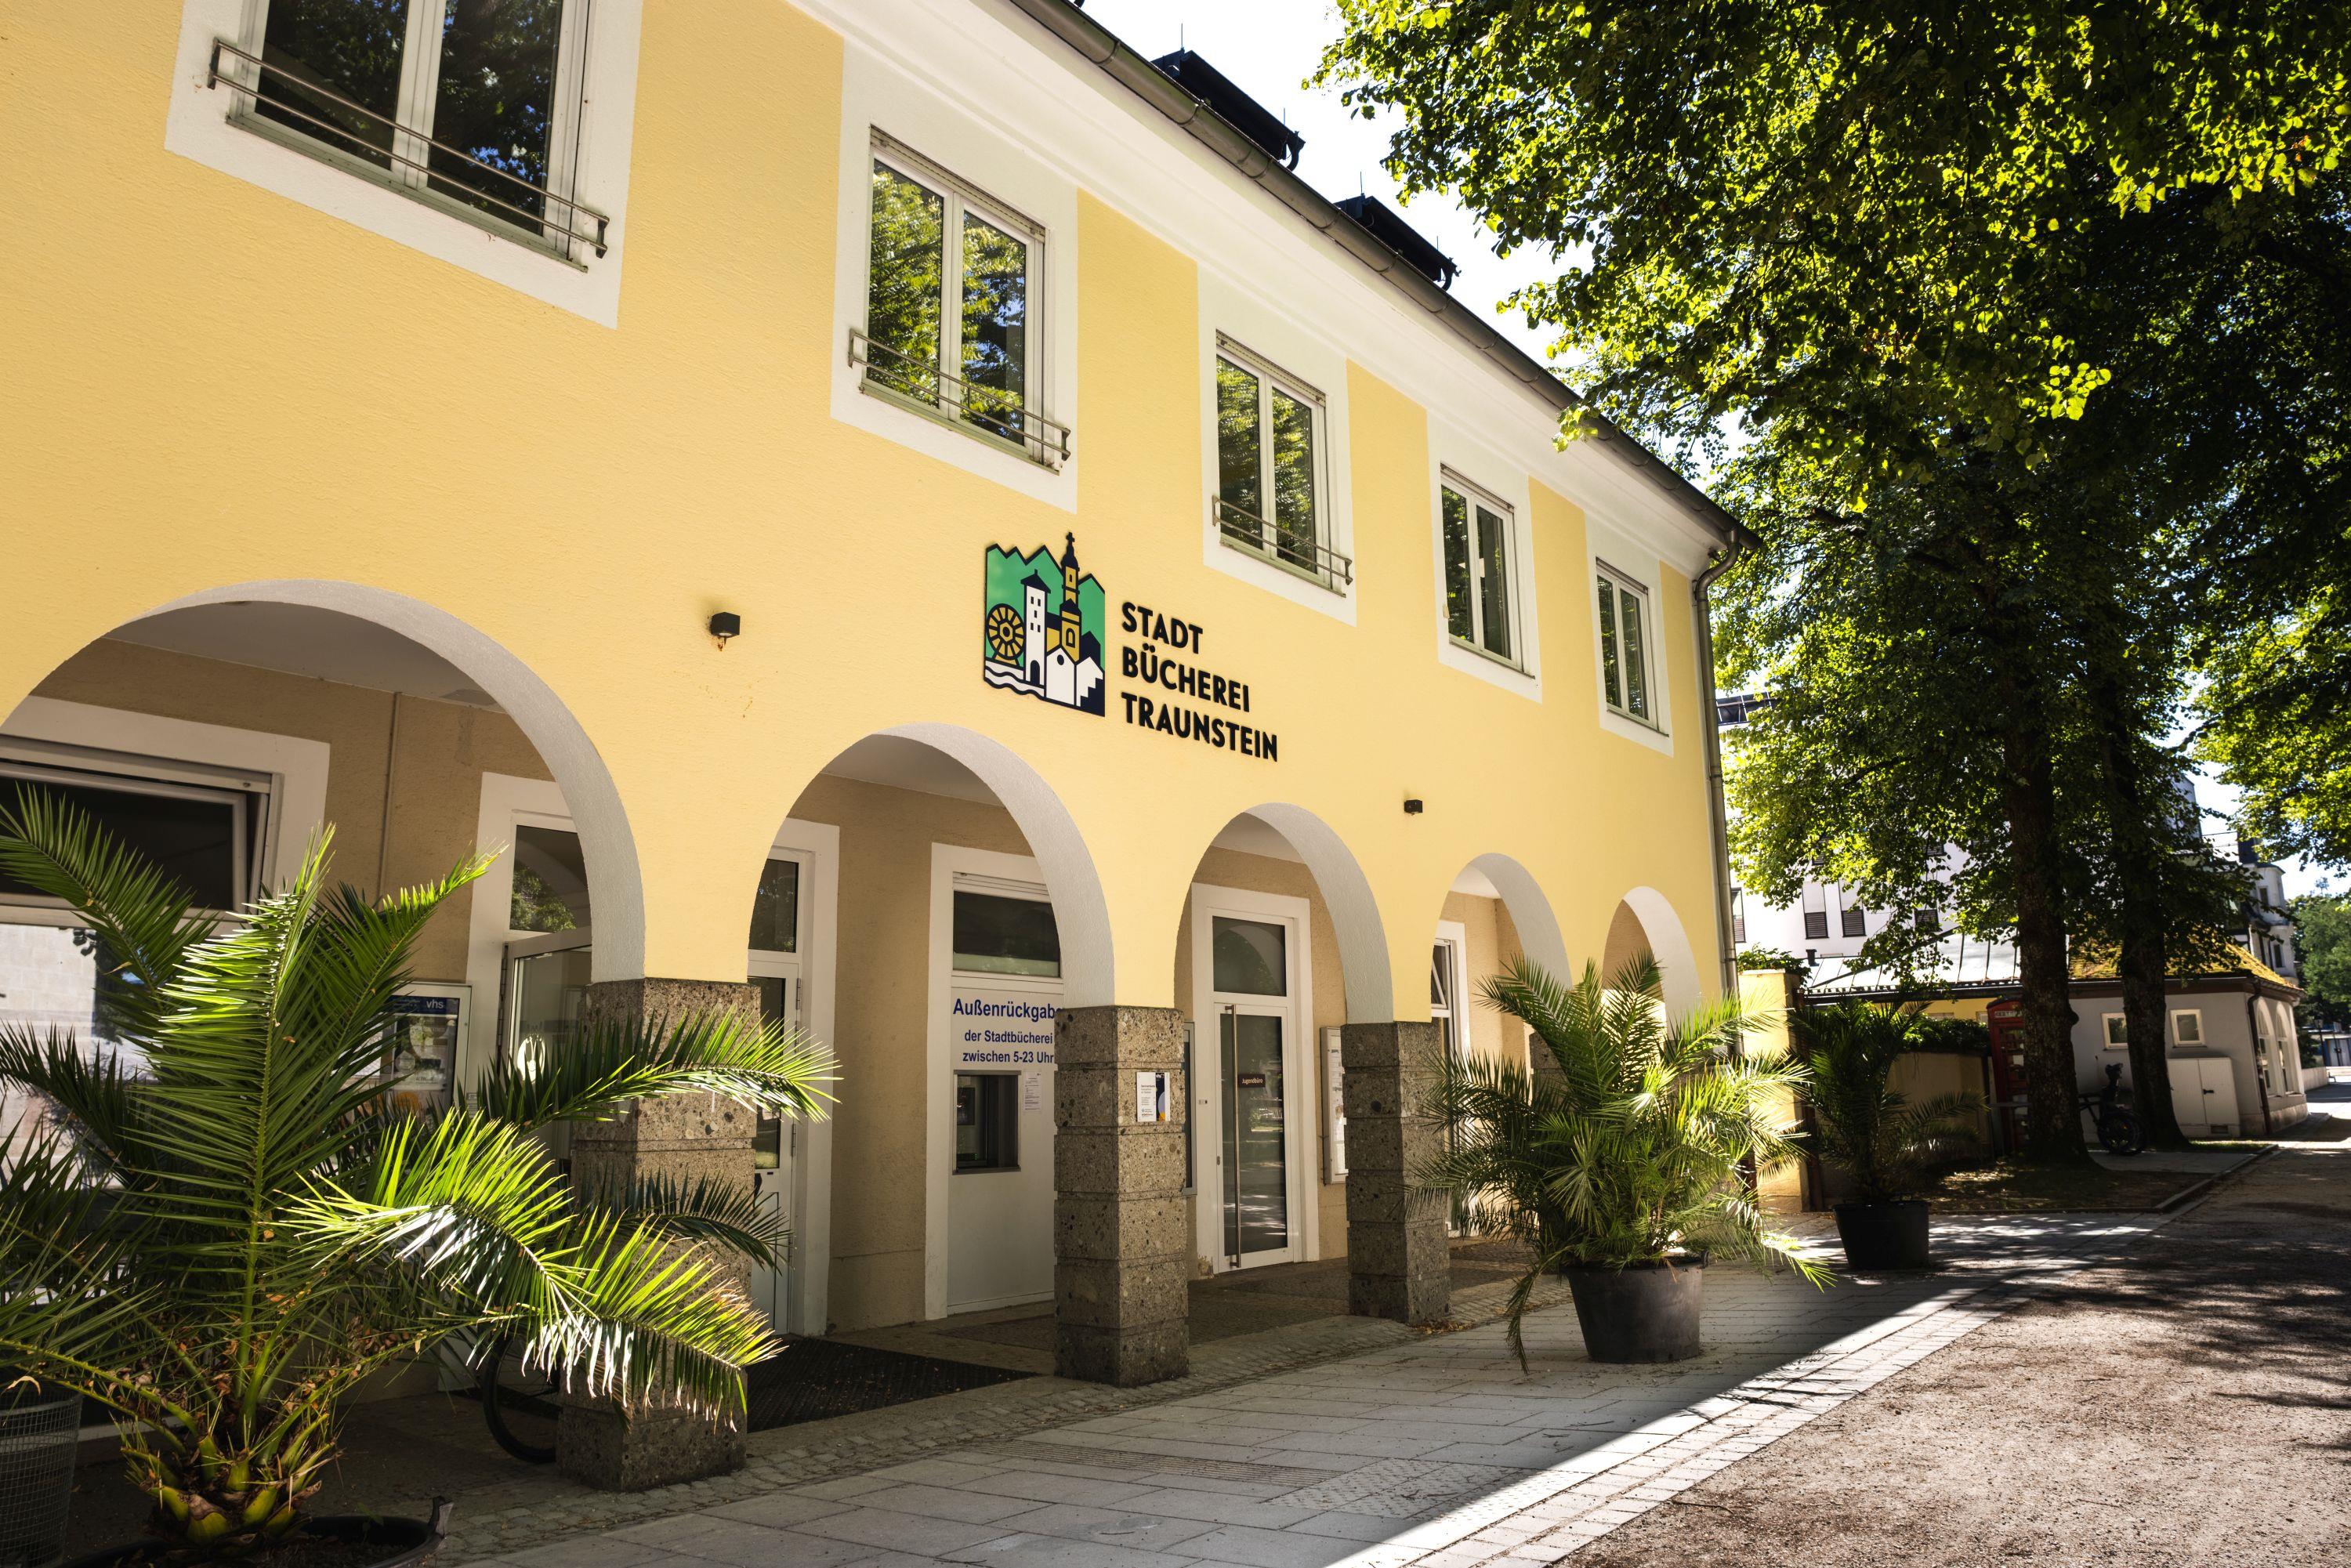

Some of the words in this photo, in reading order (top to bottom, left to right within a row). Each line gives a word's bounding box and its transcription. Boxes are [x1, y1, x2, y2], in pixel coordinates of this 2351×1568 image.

[1121, 601, 1204, 654] STADT
[1121, 643, 1250, 712] BÜCHEREI
[1121, 692, 1278, 762] TRAUNSTEIN
[426, 999, 444, 1009] vhs
[964, 1030, 982, 1041] der
[984, 1030, 1053, 1044] Stadtbücherei
[962, 1050, 1010, 1063] zwischen
[1013, 1051, 1034, 1063] 5-23
[1037, 1052, 1054, 1063] Uhr
